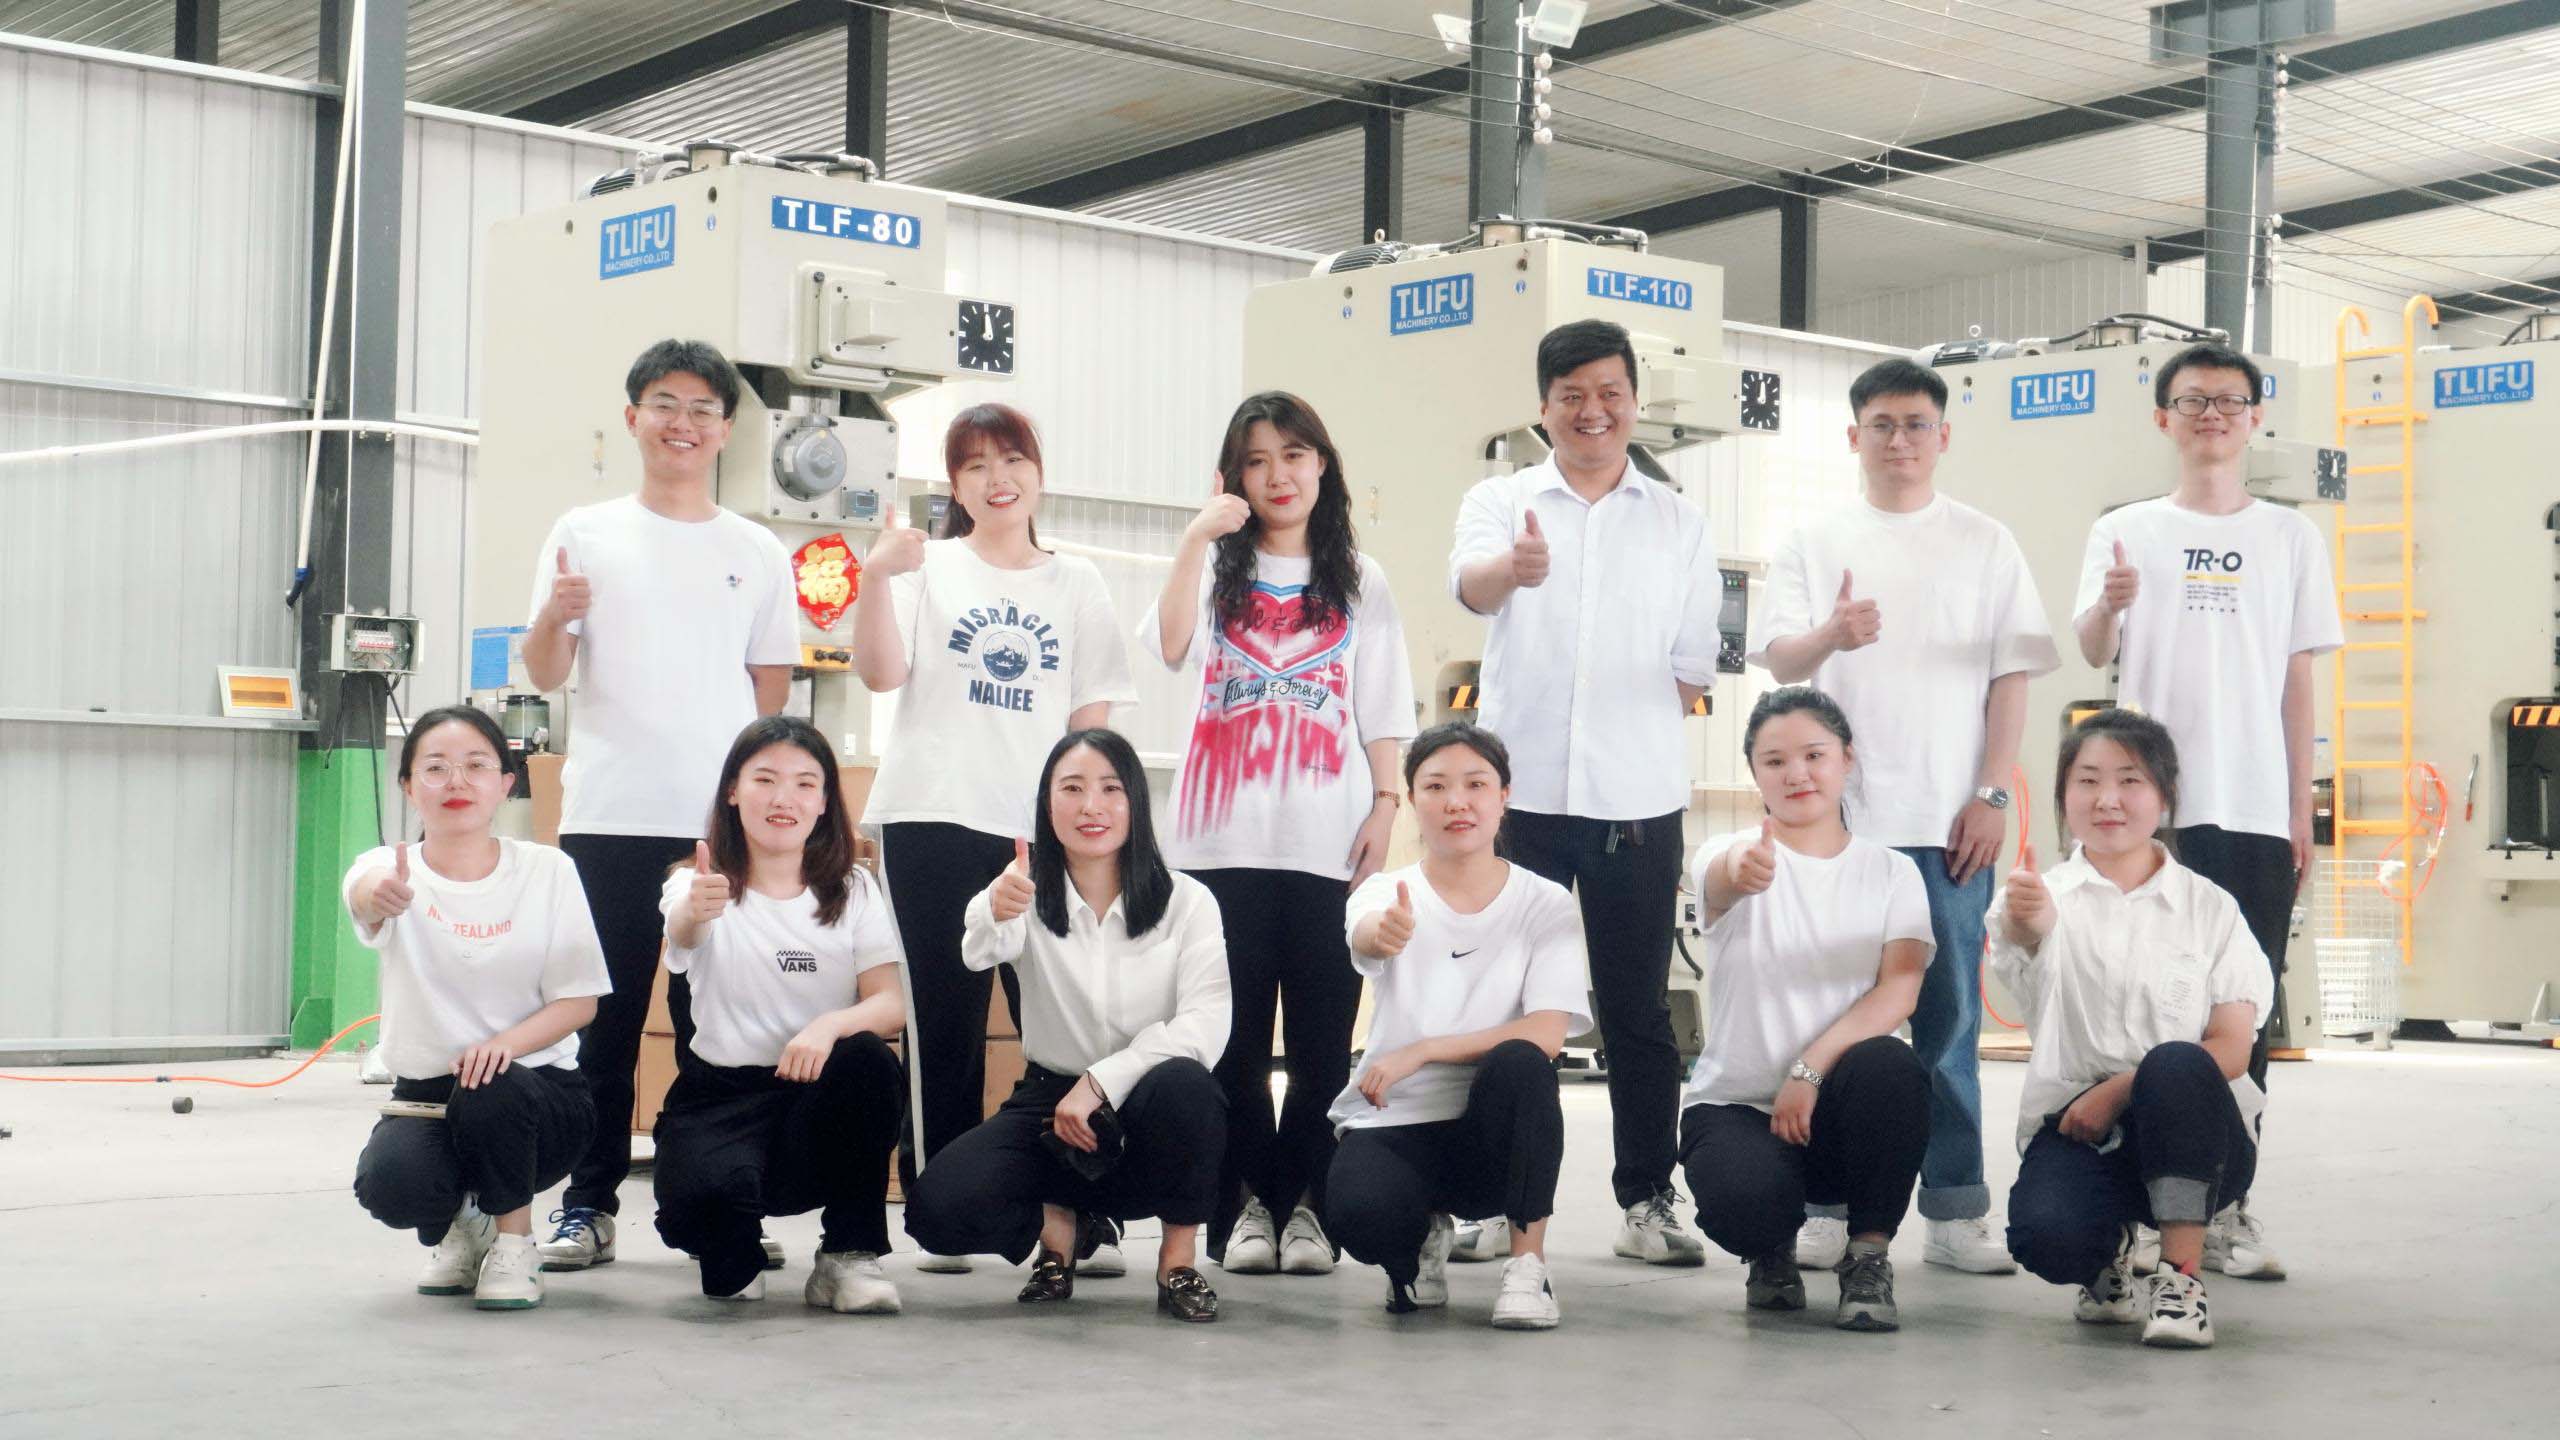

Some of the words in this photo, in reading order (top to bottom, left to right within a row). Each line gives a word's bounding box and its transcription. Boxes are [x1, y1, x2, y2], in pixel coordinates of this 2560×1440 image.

[606, 212, 670, 259] TLIFU
[782, 200, 912, 244] TLF-80
[1396, 279, 1468, 318] TLIFU
[1594, 270, 1687, 307] TLF-110
[1396, 316, 1438, 329] MACHINERY
[2017, 374, 2089, 405] TLIFU
[2440, 364, 2529, 396] TLIFU
[2016, 406, 2059, 415] MACHINERY
[798, 543, 851, 608] 福
[948, 606, 1059, 671] MISRACLEN
[969, 680, 1033, 712] NALIEE
[453, 919, 512, 938] ZEALAND
